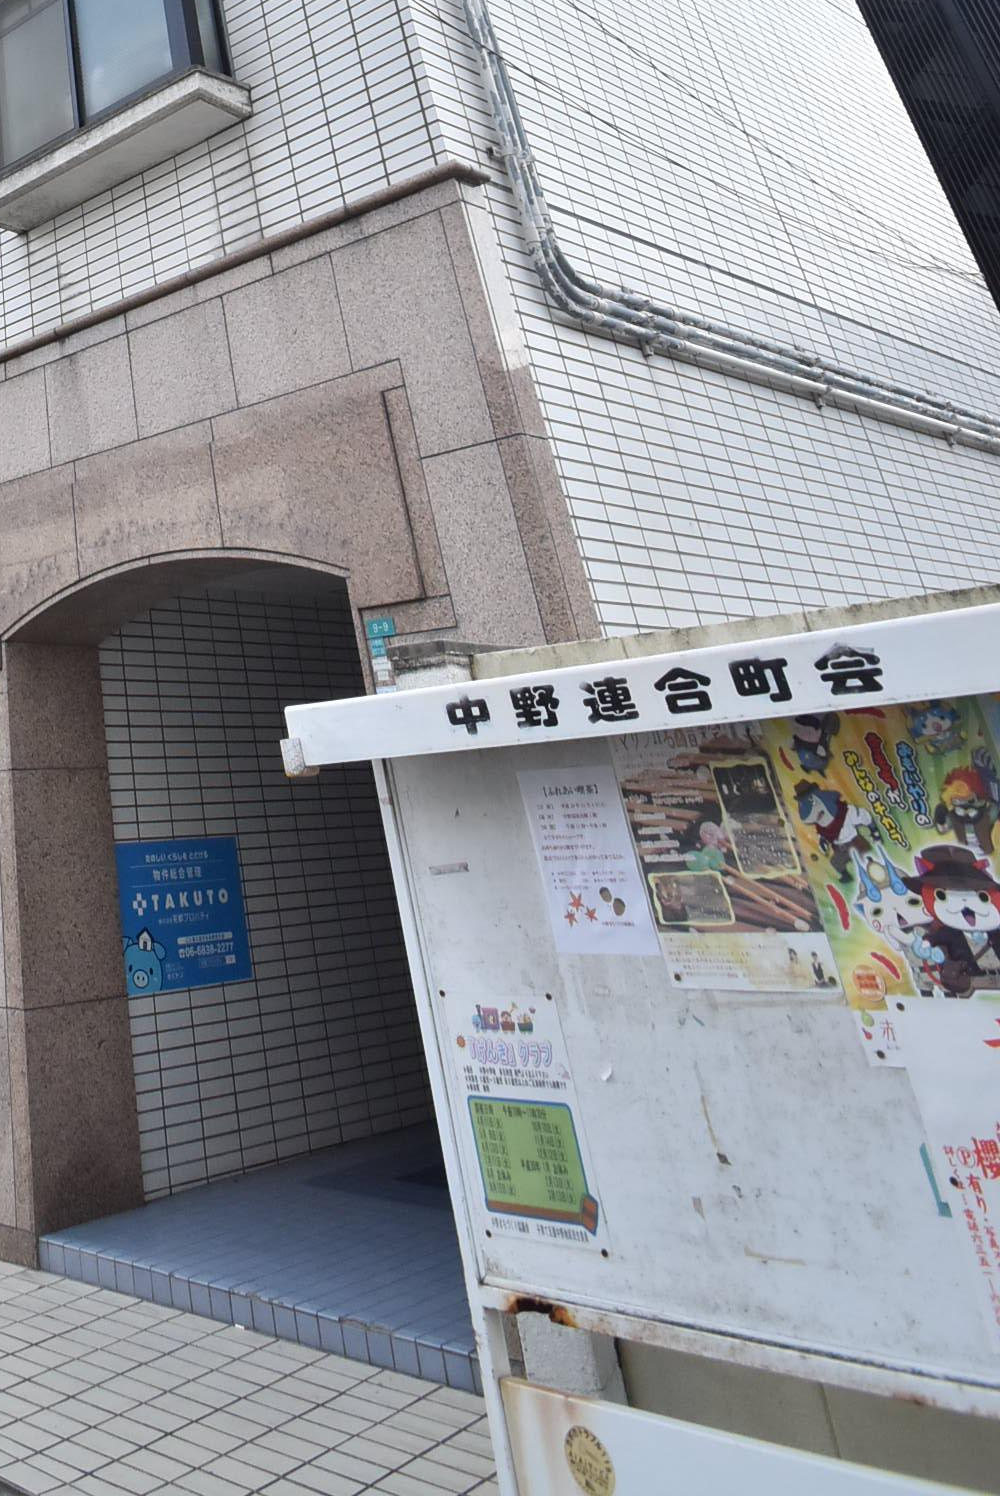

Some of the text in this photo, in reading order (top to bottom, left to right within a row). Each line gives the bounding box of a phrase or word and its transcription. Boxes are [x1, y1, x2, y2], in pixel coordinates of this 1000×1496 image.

[372, 622, 389, 633] 9-9
[446, 641, 884, 736] 中野連合町会
[151, 888, 229, 911] TAKUTO
